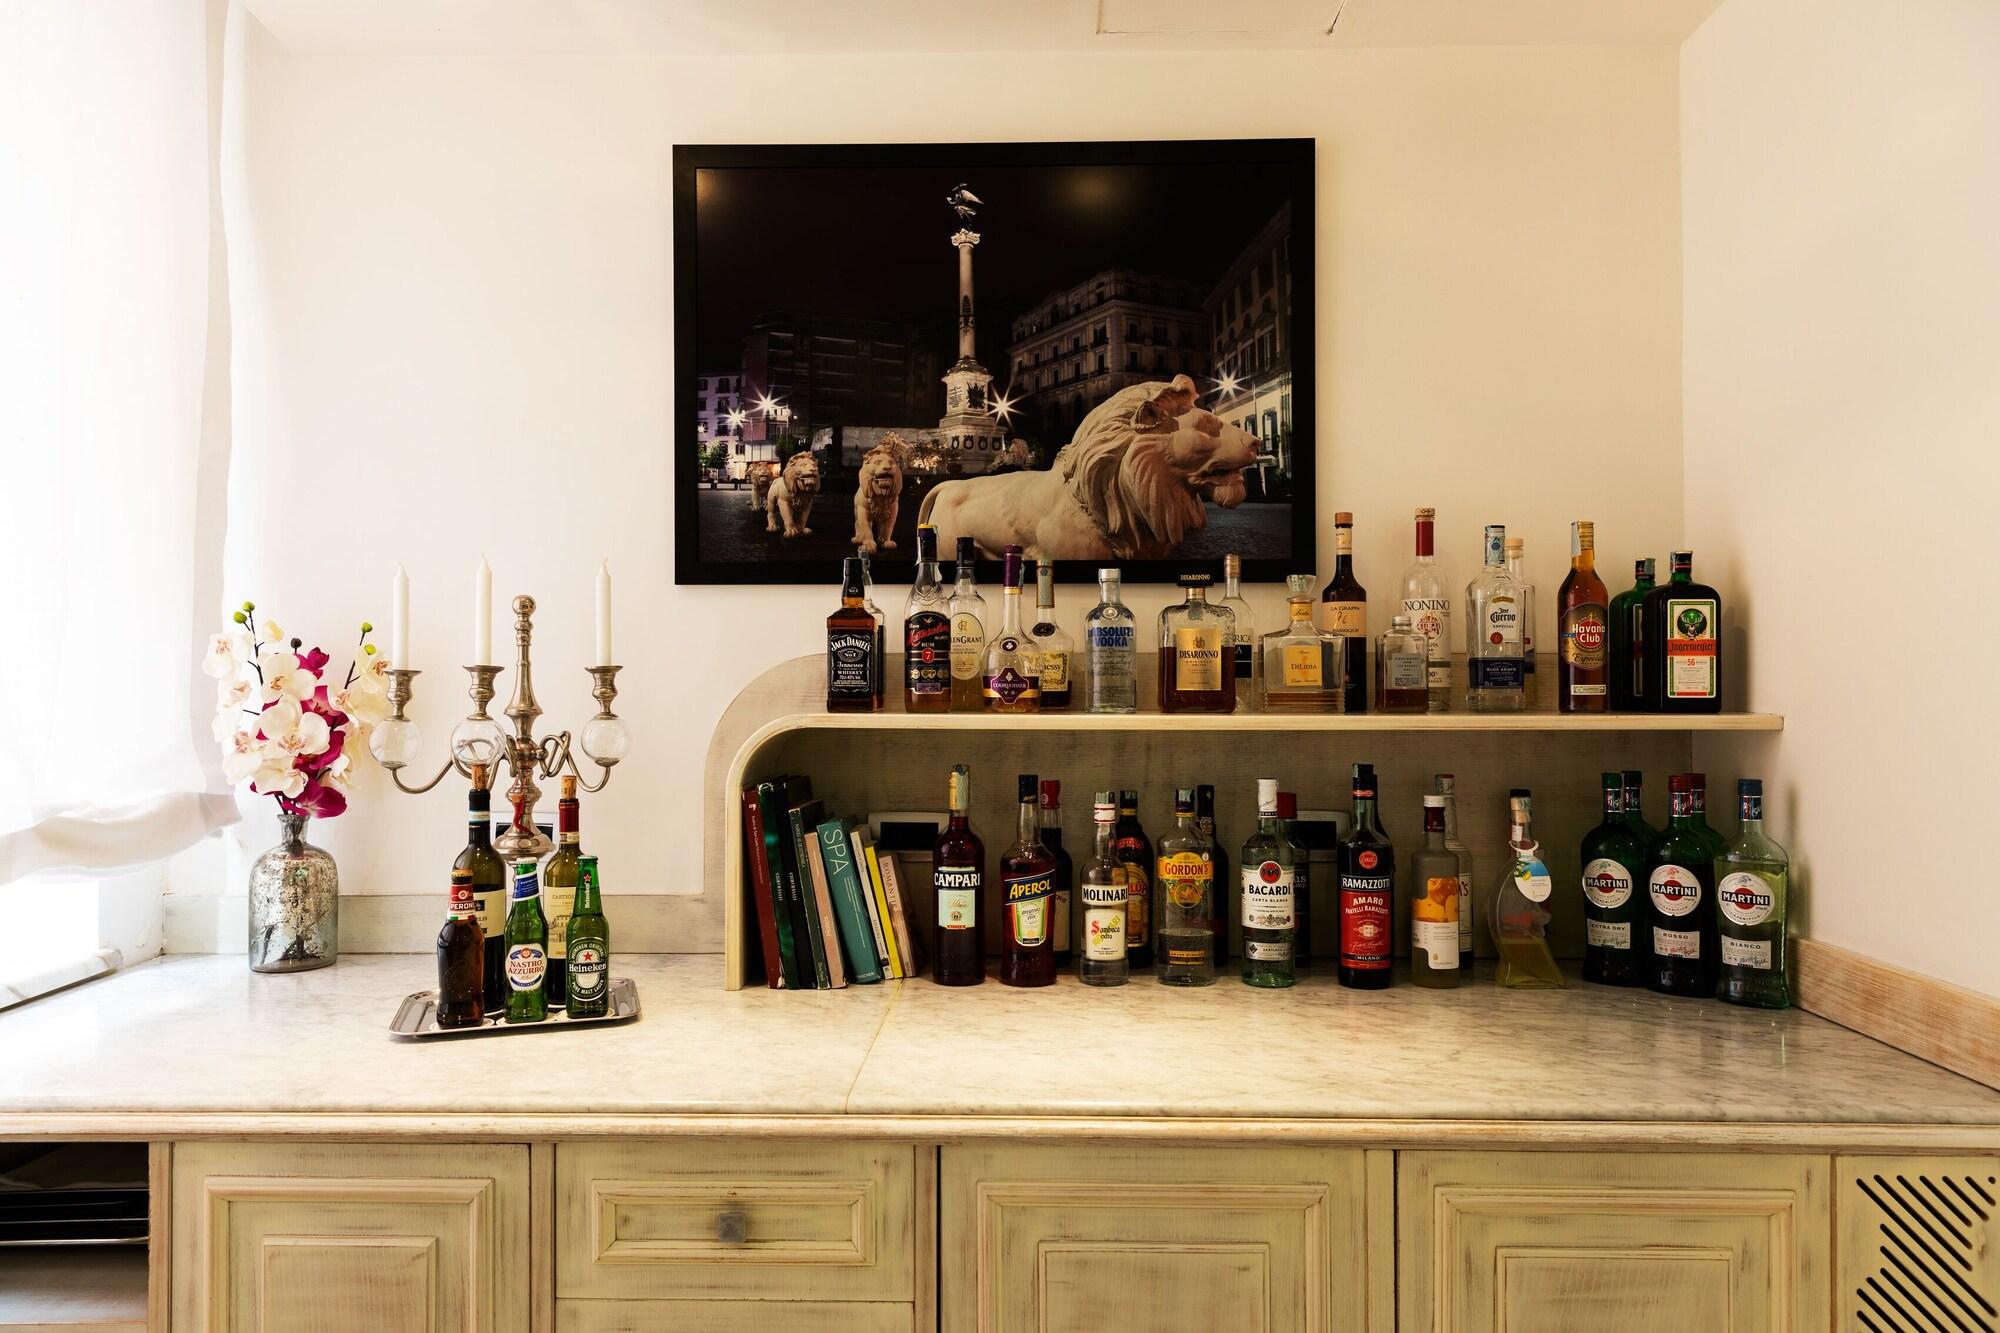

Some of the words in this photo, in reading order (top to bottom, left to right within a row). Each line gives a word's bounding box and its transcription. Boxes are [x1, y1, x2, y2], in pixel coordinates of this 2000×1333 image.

[1404, 599, 1450, 612] NONINO
[1490, 612, 1516, 623] Cuervo
[1572, 623, 1606, 633] Havana
[1095, 637, 1128, 647] VODKA
[1580, 633, 1601, 643] Club
[831, 640, 847, 652] JACK
[847, 636, 871, 652] DANIEL'S
[1179, 649, 1219, 659] DISARONNO
[823, 829, 849, 875] SPA
[1164, 862, 1209, 876] GORDON'S
[934, 872, 981, 887] CAMPARI
[1585, 876, 1628, 888] MARTINI
[1009, 879, 1051, 900] APEROL
[1083, 887, 1128, 901] MOLINARI
[1653, 883, 1696, 896] MARTINI
[1352, 896, 1384, 906] AMARO
[1722, 892, 1770, 905] MARTINI
[1662, 932, 1689, 940] ROSSO
[1730, 941, 1761, 950] BIANCO
[510, 959, 543, 968] NASTRO
[569, 962, 607, 973] Heineken
[508, 965, 545, 974] AZZURRO
